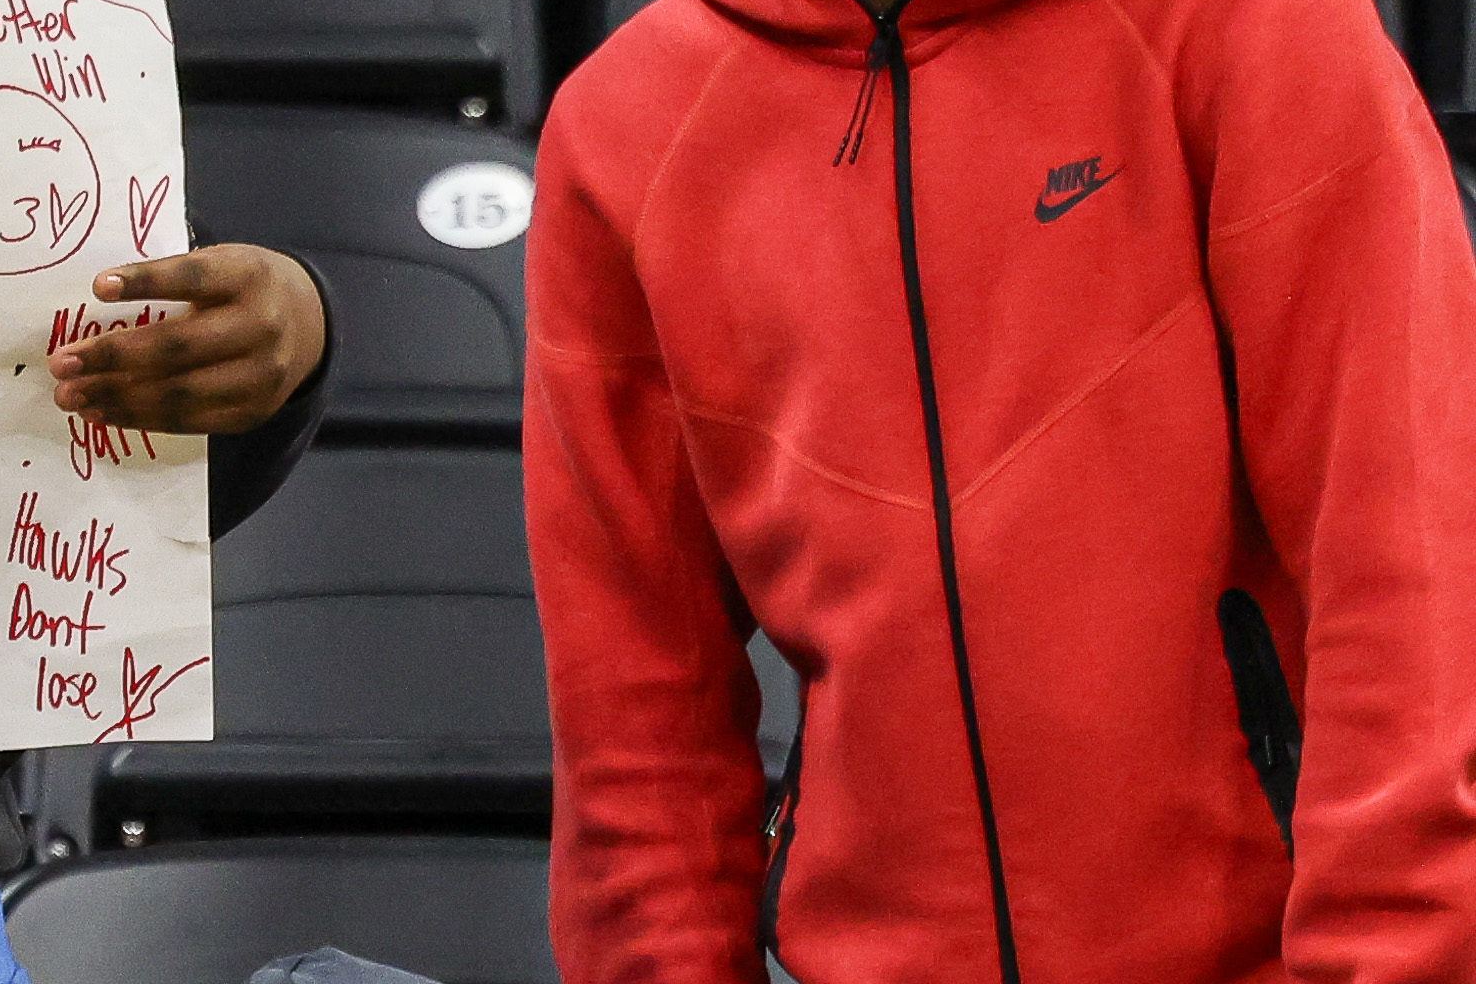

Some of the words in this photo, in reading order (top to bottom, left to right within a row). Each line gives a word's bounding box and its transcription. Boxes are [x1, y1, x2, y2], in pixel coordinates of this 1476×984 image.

[1046, 155, 1102, 195] NIKE
[451, 193, 507, 231] 15
[35, 655, 103, 721] lose
